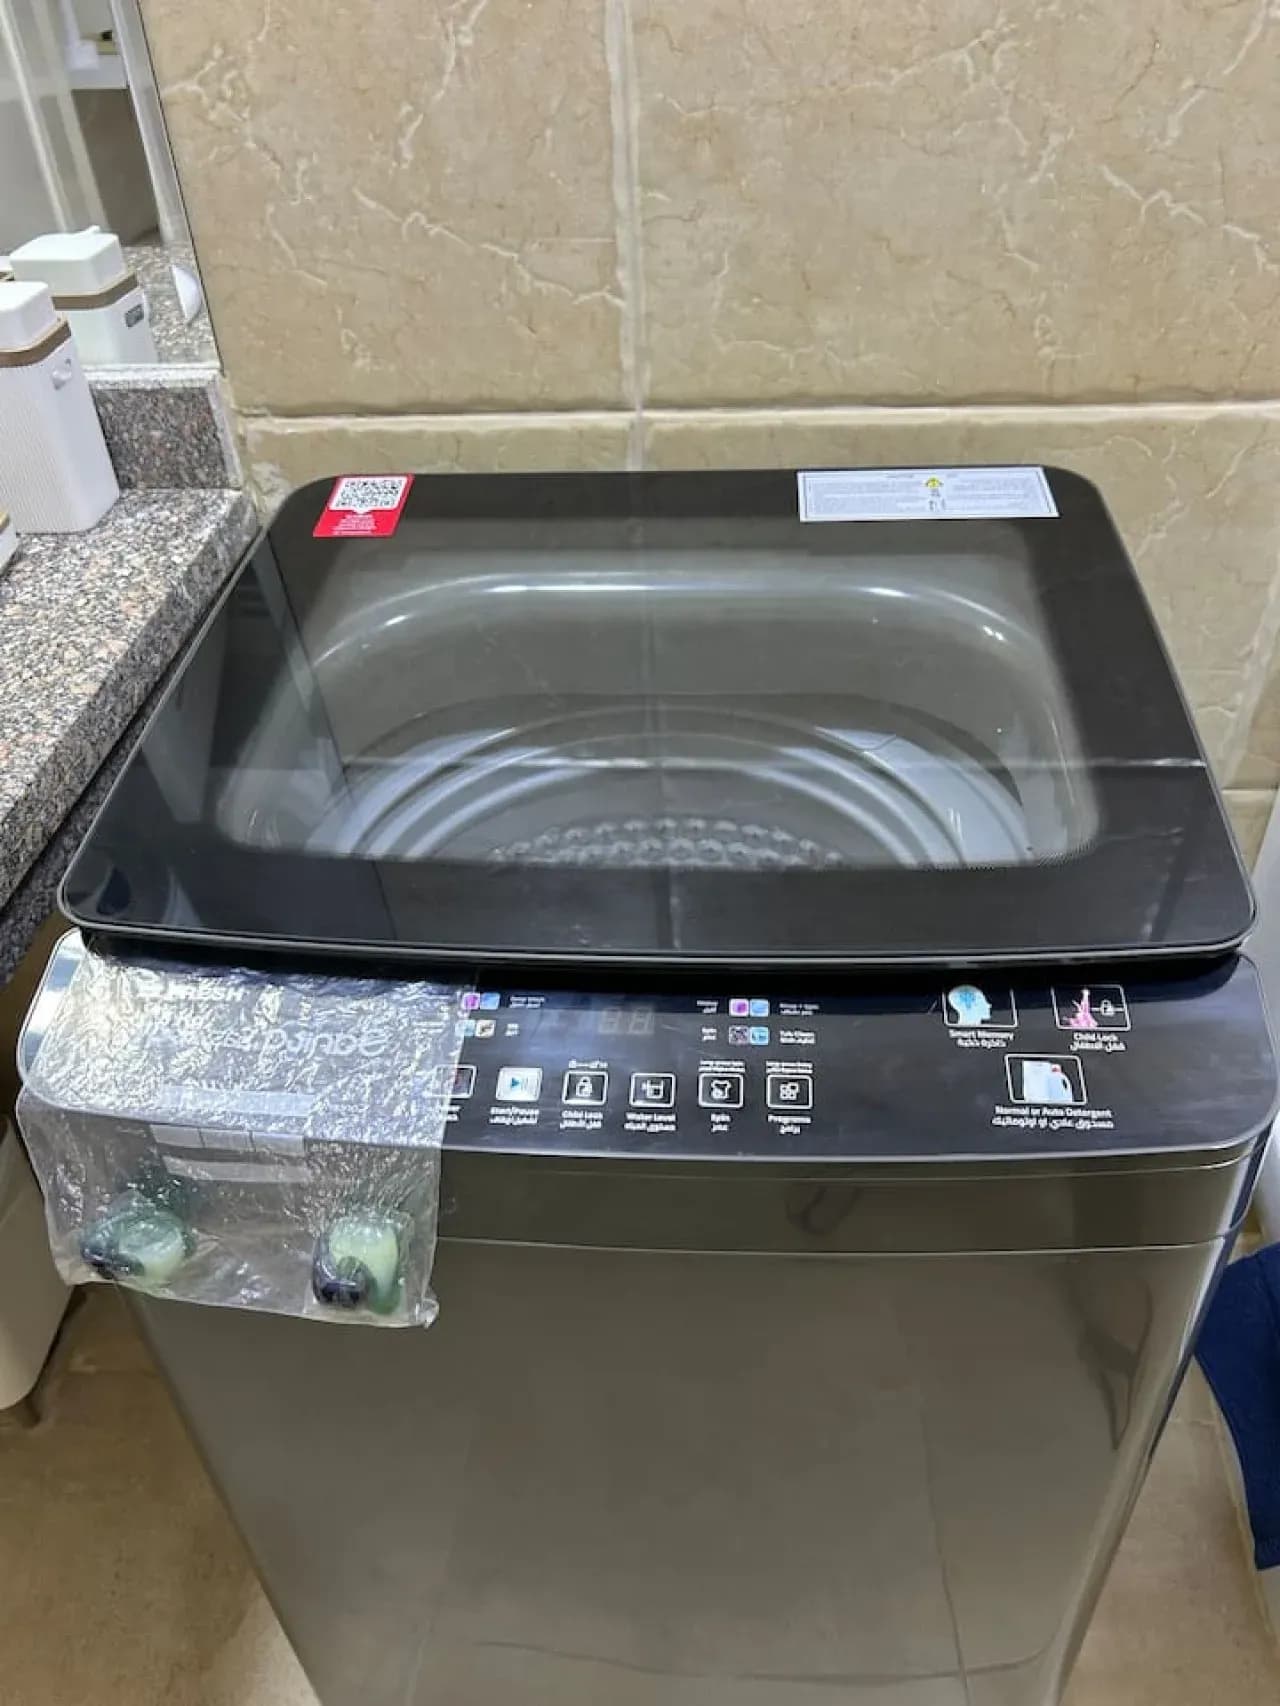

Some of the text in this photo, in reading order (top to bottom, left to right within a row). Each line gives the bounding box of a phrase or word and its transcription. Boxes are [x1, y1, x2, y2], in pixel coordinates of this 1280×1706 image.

[1073, 1031, 1117, 1041] Child Lock
[561, 1109, 604, 1118] Child Lock
[625, 1111, 676, 1122] Water Level
[995, 1105, 1113, 1119] Normal or Auto Detergent
